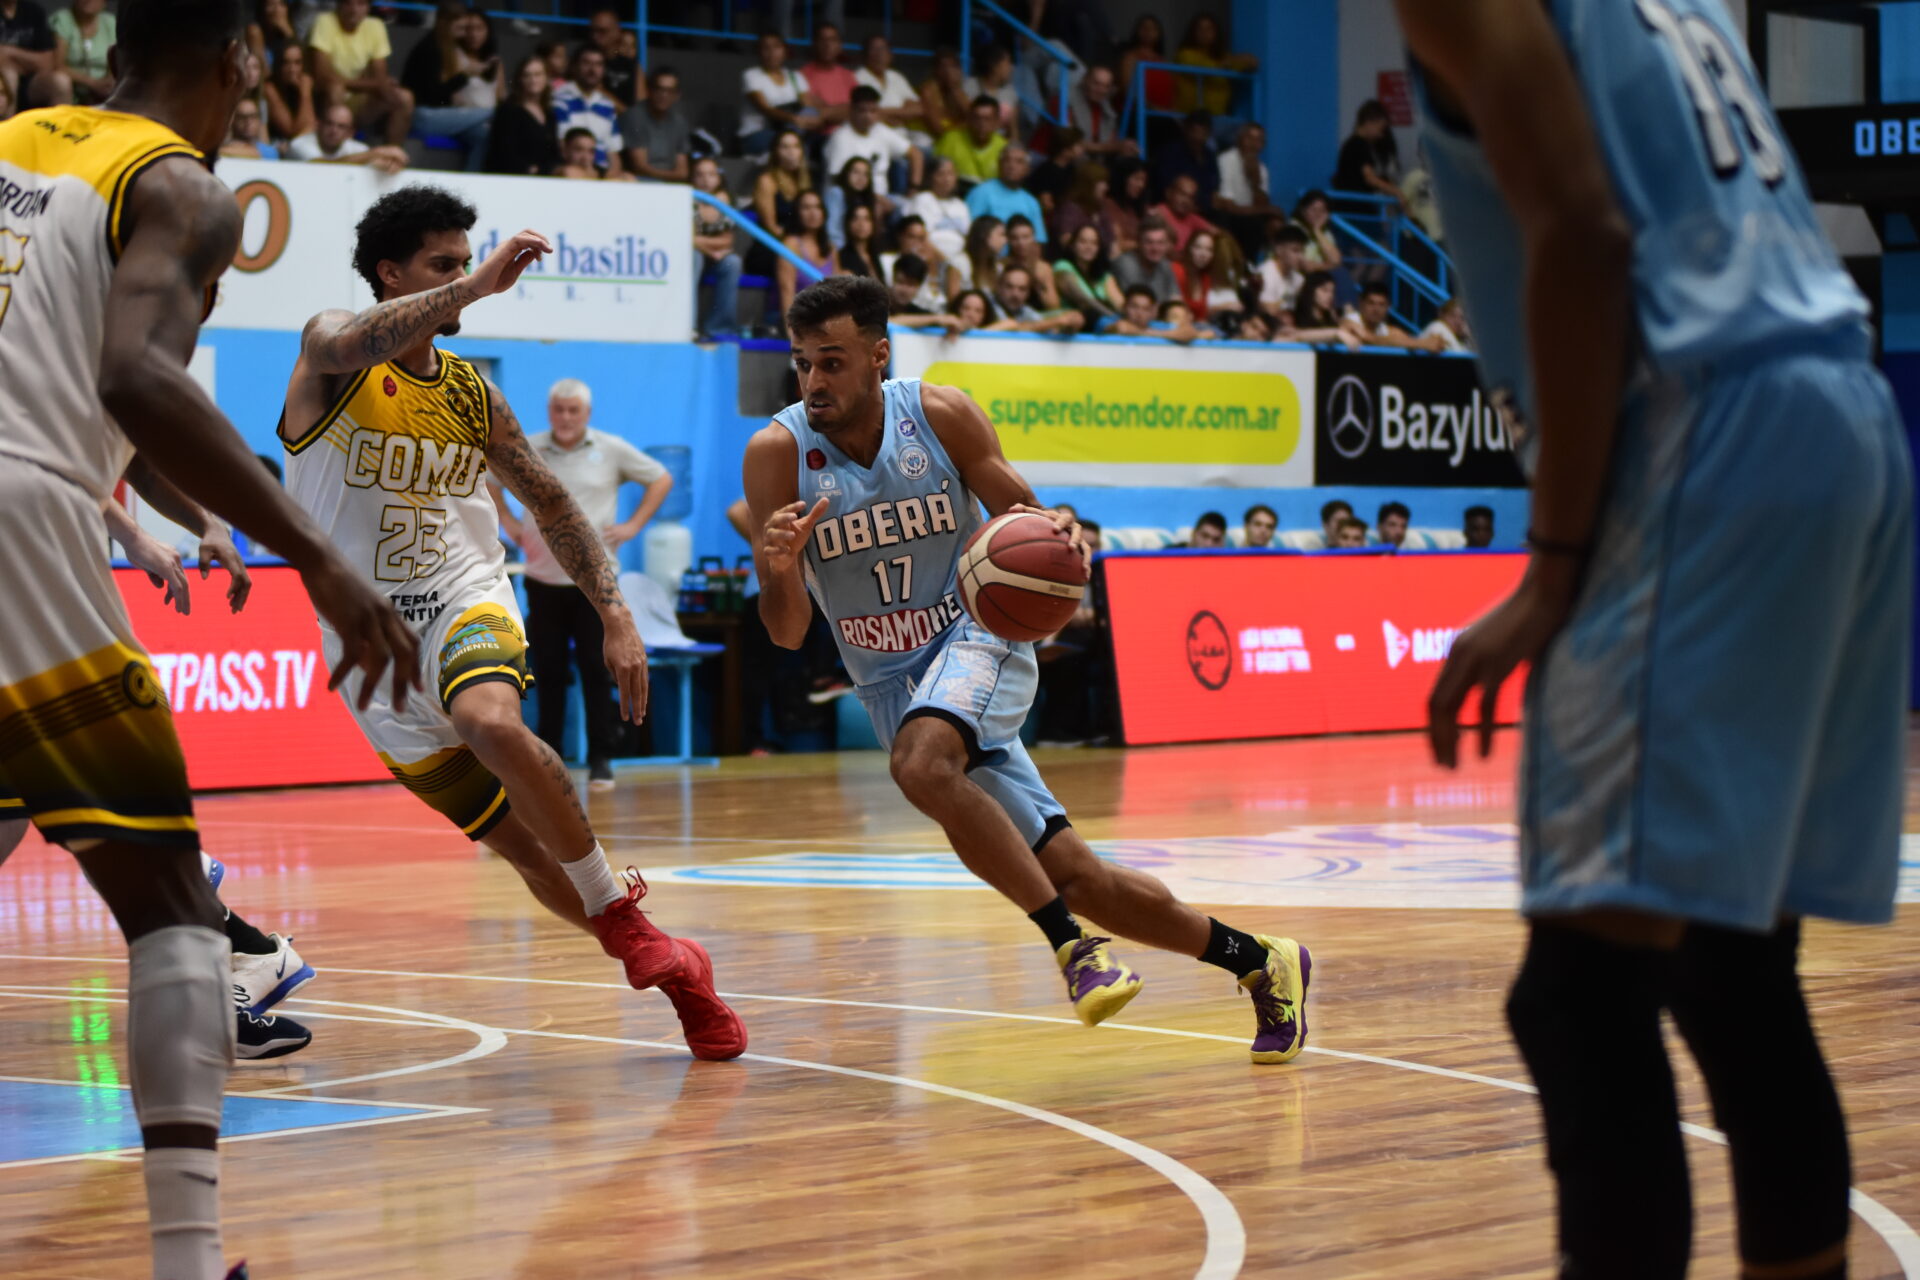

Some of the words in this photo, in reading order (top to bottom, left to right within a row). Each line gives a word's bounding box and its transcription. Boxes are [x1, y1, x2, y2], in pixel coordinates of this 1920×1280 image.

[556, 231, 669, 279] basilio
[1379, 385, 1515, 467] Bazylu
[344, 426, 485, 498] COMU
[375, 504, 448, 582] 23
[813, 479, 957, 561] OBERÁ
[390, 590, 439, 607] TERIA
[871, 554, 913, 606] 17
[402, 602, 447, 622] NTIN
[150, 650, 317, 713] TPASS.TV
